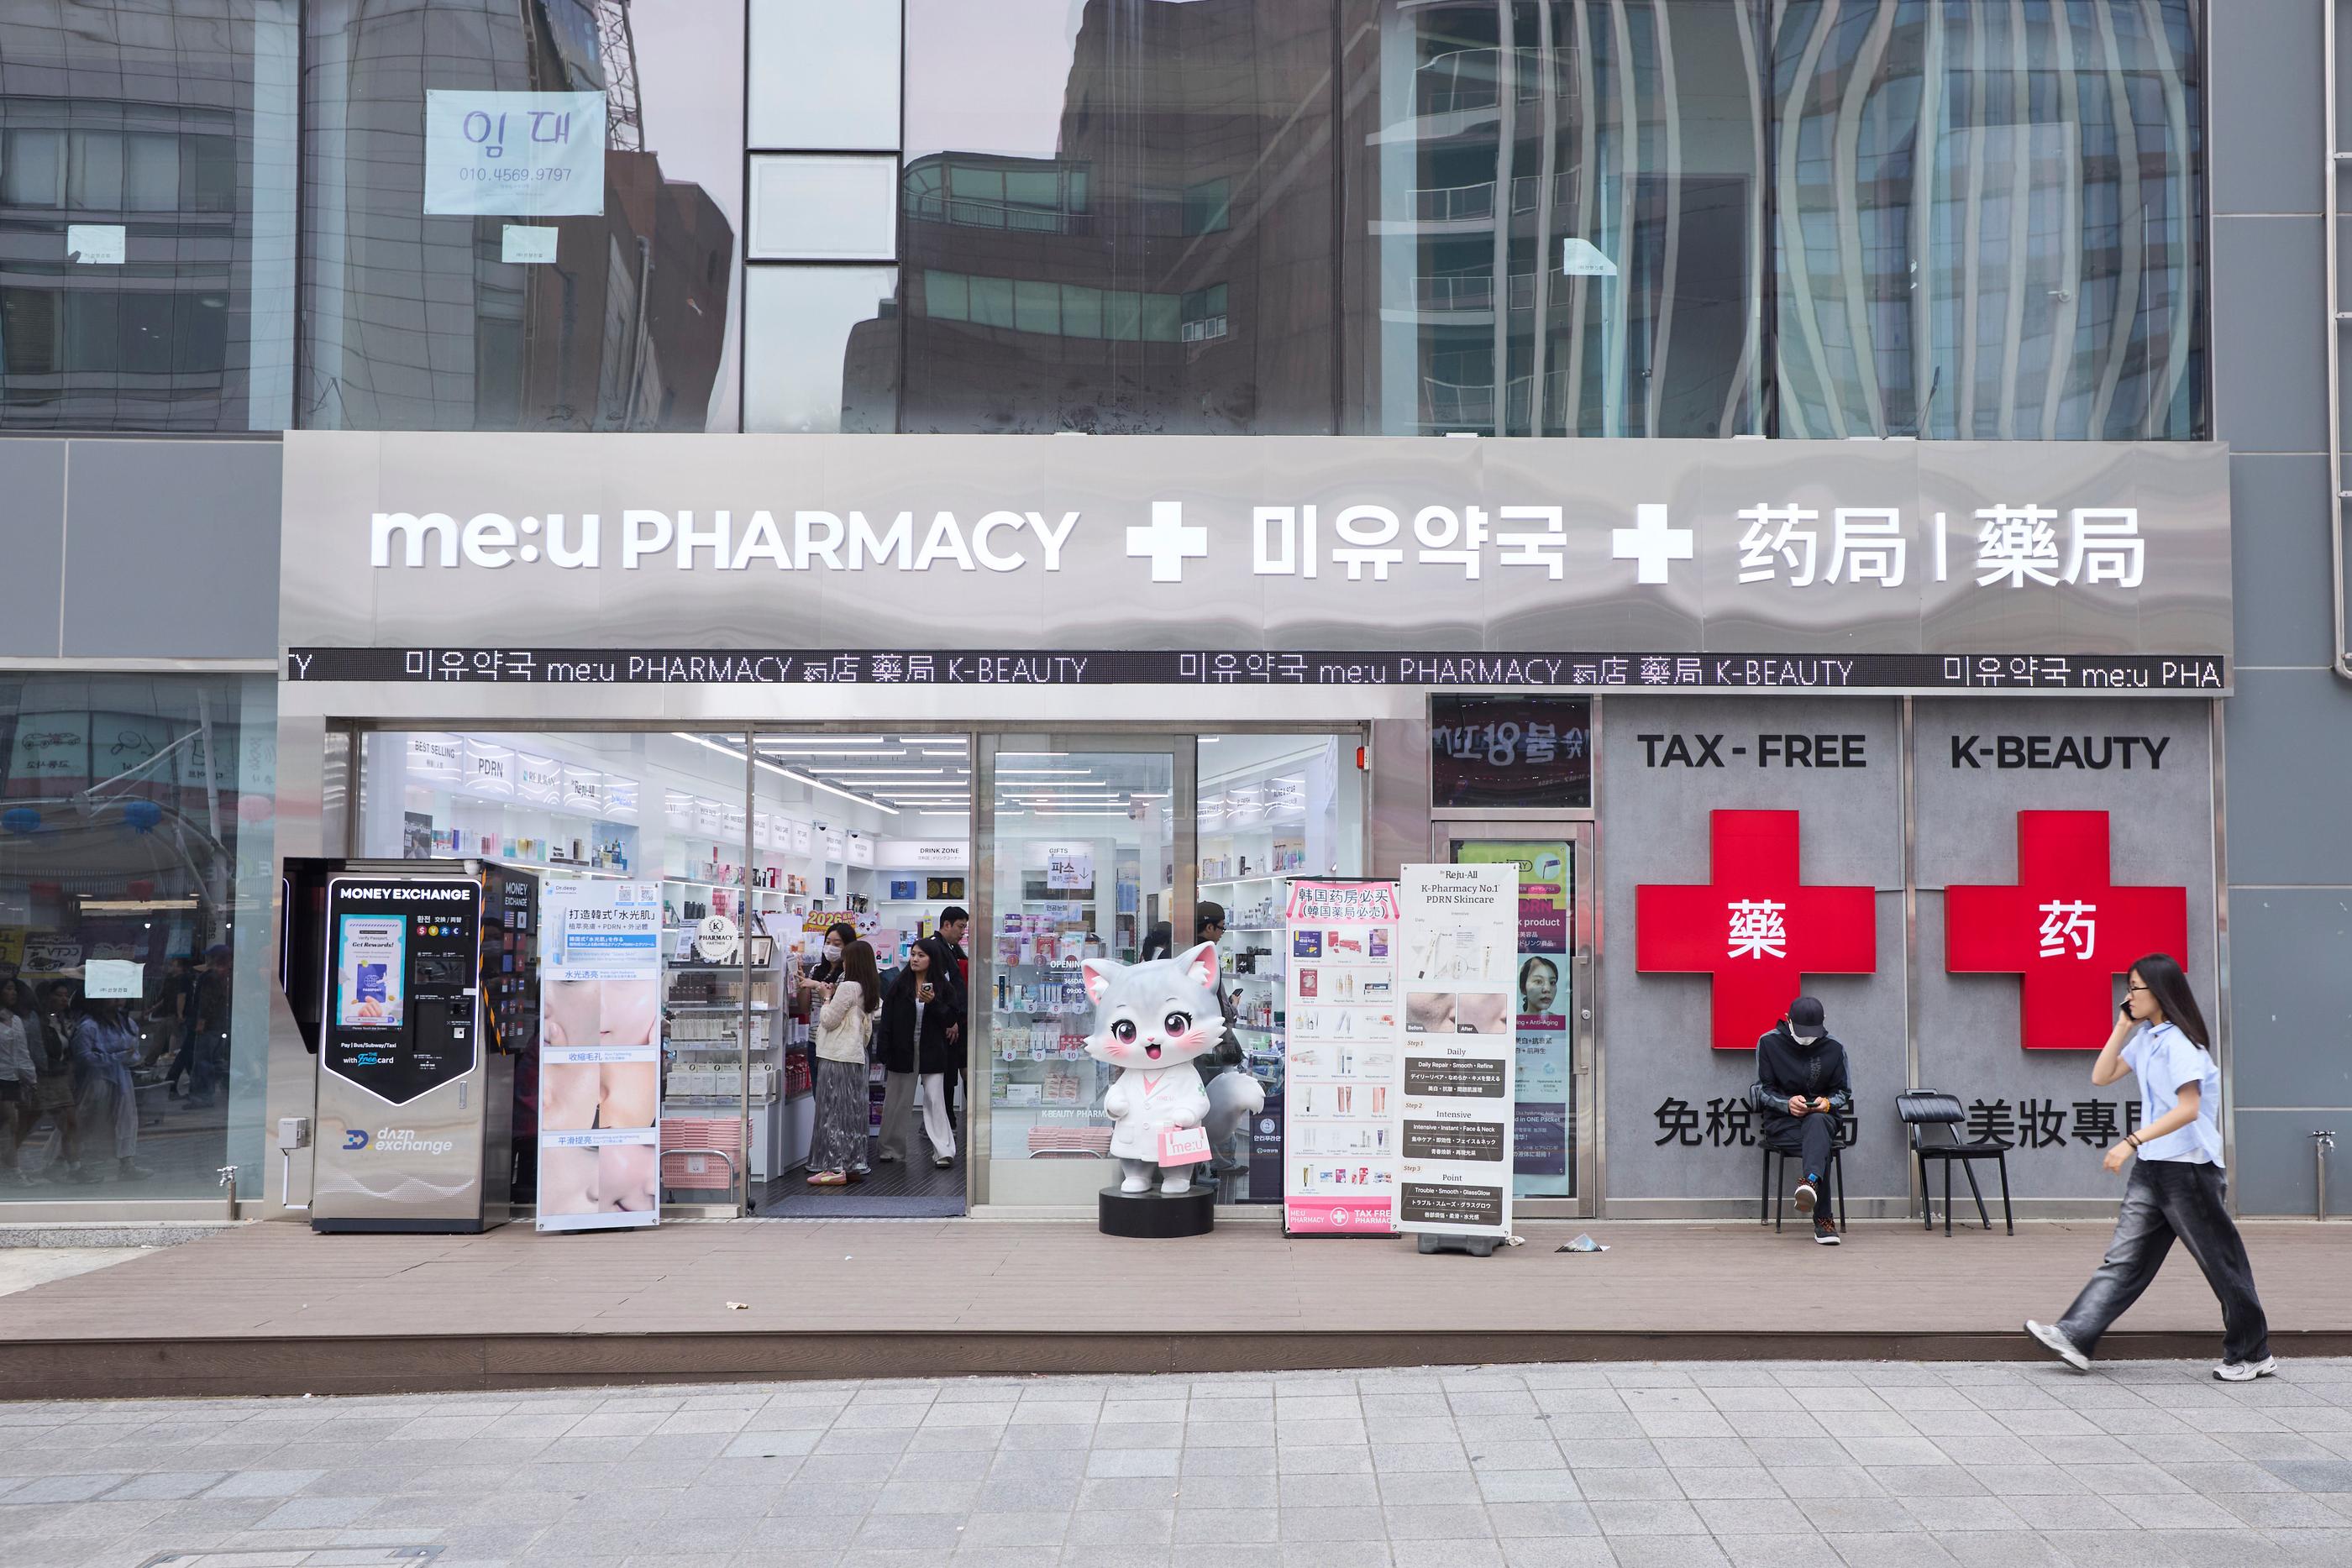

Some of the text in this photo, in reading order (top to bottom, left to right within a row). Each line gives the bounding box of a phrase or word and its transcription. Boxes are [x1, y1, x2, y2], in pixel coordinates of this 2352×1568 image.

[459, 167, 572, 182] 010.4569.9797
[370, 508, 1081, 574] me:u PHARMACY
[1252, 504, 1567, 582] 미유약국
[1737, 501, 2145, 590] 药局 藥局
[406, 650, 537, 682] 미유약국
[547, 661, 615, 682] me:u
[628, 655, 793, 683] PHARMACY
[870, 653, 935, 683] 藥局
[948, 657, 1089, 683] K-BEAUTY
[1179, 652, 1309, 684] 미유약국
[1319, 662, 1386, 684] me:u
[1400, 657, 1564, 684] PHARMACY
[1640, 656, 1704, 685] 藥局
[1716, 658, 1855, 687] K-BEAUTY
[1944, 656, 2071, 687] 미유약국
[2081, 664, 2149, 688] me:u
[2161, 662, 2222, 689] PHA
[415, 740, 455, 759] BEST SELLING
[1950, 735, 2171, 769] K-BEAUTY
[478, 758, 503, 779] PDRN
[1051, 862, 1075, 874] 파스
[1446, 870, 1478, 880] Reju-All
[340, 887, 470, 901] MONEY EXCHANGE
[505, 881, 528, 896] MONEY
[1421, 884, 1499, 895] K-Pharmacy No.1
[504, 896, 528, 908] EXCHANGE
[1299, 887, 1389, 905] 韩国药房必买
[1426, 895, 1494, 904] PDRN Skincare
[1518, 898, 1552, 915] DRN
[417, 915, 431, 924] 환전
[807, 911, 843, 926] 2026
[1524, 918, 1561, 928] product
[1726, 899, 1787, 959] 藥
[2039, 899, 2097, 960] 药
[1050, 960, 1082, 968] OPENIN
[1530, 1019, 1559, 1027] Anti-Aging
[1446, 1047, 1467, 1057] Daily
[343, 1056, 357, 1064] with
[357, 1053, 377, 1067] Free
[377, 1056, 394, 1064] card
[1405, 1101, 1418, 1109] Step
[1042, 1109, 1074, 1118] K-BEAUTY
[1436, 1110, 1472, 1119] Intensive
[1653, 1096, 1858, 1148] 免稅
[375, 1138, 453, 1155] exchange
[1172, 1140, 1203, 1154] me:u
[1404, 1165, 1416, 1173] Step
[1442, 1173, 1462, 1182] Point
[1354, 1209, 1391, 1218] TAX FRE
